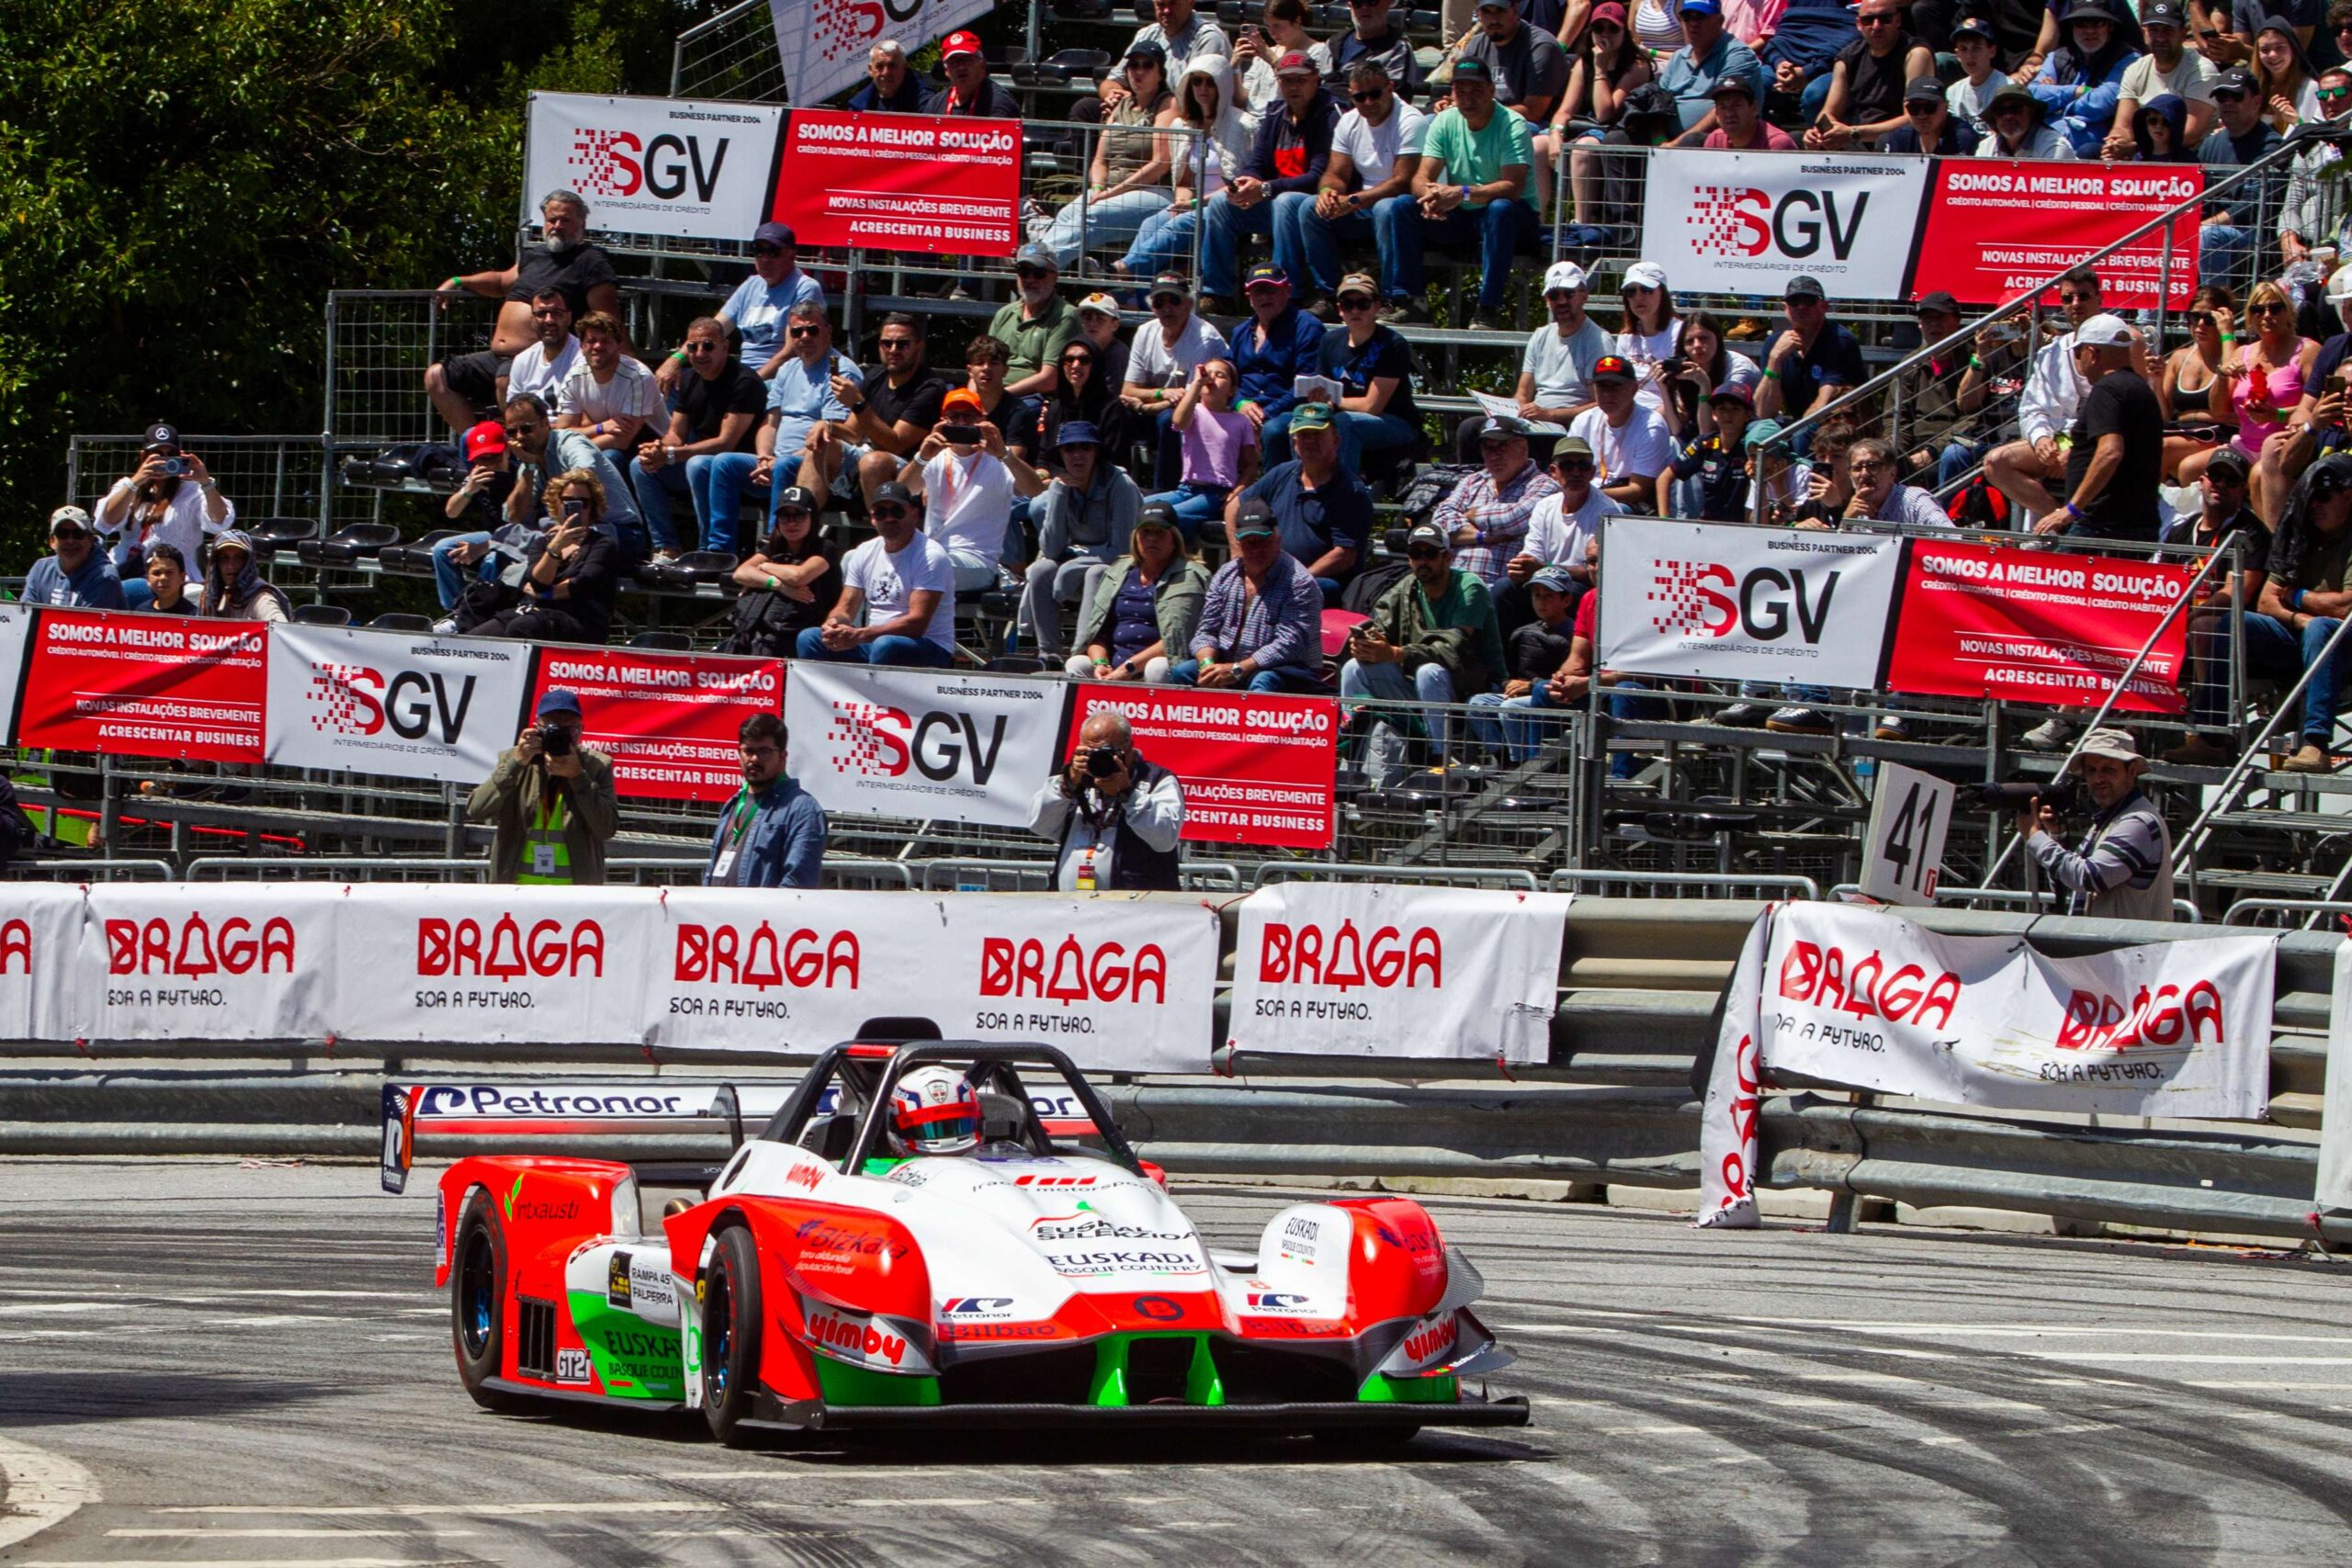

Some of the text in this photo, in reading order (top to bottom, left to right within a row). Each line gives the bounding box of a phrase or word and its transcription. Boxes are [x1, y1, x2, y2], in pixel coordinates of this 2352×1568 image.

[669, 111, 706, 120] BUSINESS
[707, 113, 741, 123] PARTNER
[797, 123, 1013, 152] SOMOS A MELHOR SOLUÇÃO
[797, 144, 827, 154] CRÉDITO
[828, 147, 870, 158] AUTOMÓVEL
[875, 150, 904, 159] CRÉDITO
[905, 152, 937, 161] PESSOAL
[941, 152, 969, 163] CRÉDITO
[600, 130, 729, 202] SGV
[1801, 165, 1905, 175] BUSINESS PARTNER 2004
[1948, 174, 2194, 200] SOMOS A MELHOR SOLUÇÃO
[674, 205, 711, 214] CRÉDITO
[829, 197, 1011, 218] NOVAS INSTALAÇÕES BREVEMENTE
[1947, 196, 2145, 211] CRÉDITO AUTOMÓVEL CRÉDITO PESSOAL CRÉDITO
[850, 221, 1010, 242] ACRESCENTAR BUSINESS
[1723, 187, 1871, 261] SGV
[1982, 250, 2024, 263] NOVAS
[1792, 264, 1806, 272] DE
[1807, 264, 1847, 274] CRÉDITO
[2115, 281, 2188, 294] BUSINSS
[1768, 541, 1877, 555] BUSINESS PARTNER 2004
[1922, 555, 2180, 600] SOMOS A MELHOR SOLUÇÃO
[1689, 563, 1840, 644] SGV
[1921, 580, 2128, 609] CRÉDITO CRÉDITO PESSOAL CRÉDITO
[48, 623, 262, 654] SOMOS A MELHOR SOLUÇÃO
[47, 645, 77, 656] CRÉDITO
[78, 648, 120, 660] AUTOMÓVEL
[124, 650, 154, 661] CRÉDITO
[411, 647, 510, 661] BUSINESS PARTNER 2004
[1761, 646, 1774, 655] DE
[1776, 648, 1819, 658] CRÉDITO
[1960, 639, 2091, 663] NOVAS INSTALAÇÕES
[548, 661, 775, 694] SOMOS A MELHOR SOLUÇÃO
[1984, 669, 2097, 689] ACRESCENTAR
[628, 690, 662, 701] CRÉDITO
[663, 692, 695, 703] PESSOAL
[729, 695, 775, 707] HABITAÇÃO
[937, 685, 1043, 700] BUSINESS PARTNER 2004
[76, 699, 260, 723] NOVAS INSTALAÇÕES BREVEMENTE
[340, 666, 477, 744] SGV
[1086, 699, 1329, 734] SOMOS A MELHOR SOLUÇÃO
[99, 725, 259, 747] ACRESCENTAR BUSINESS
[863, 705, 1008, 785] SGV
[1172, 728, 1328, 748] CRÉDITO PESSOAL CRÉDITO HABITAÇÃO
[406, 744, 420, 752] DE
[581, 739, 696, 760] NOVAS INSTALAÇÕES
[613, 767, 702, 784] CRESCENTAR
[934, 786, 947, 795] DE
[949, 786, 987, 798] CRÉDITO
[1245, 788, 1325, 806] BREVEMENTE
[1252, 815, 1325, 831] BUSINESS
[1883, 782, 1938, 892] 41
[105, 911, 294, 981] BRAGA
[417, 912, 604, 982] BRAGA
[1260, 919, 1442, 992] BRAGA
[674, 920, 860, 992] BRAGA
[979, 934, 1166, 1007] BRAGA
[1780, 940, 1962, 1031] BRAGA
[108, 989, 133, 1006] SOA
[140, 989, 152, 1006] A
[416, 991, 447, 1008] SOA
[452, 992, 463, 1008] A
[670, 998, 703, 1015] SOA
[708, 999, 718, 1016] A
[1256, 999, 1285, 1015] SOA
[1291, 1000, 1301, 1018] A
[976, 1012, 1008, 1030] SOA
[1013, 1014, 1023, 1030] A
[1800, 1023, 1815, 1039] A
[2073, 1064, 2086, 1082] A
[470, 1087, 681, 1114] Petronor
[1285, 1216, 1320, 1242] EUSKADI
[1296, 1242, 1316, 1256] COUNTRY
[1045, 1252, 1195, 1266] EUSKADI
[1120, 1263, 1202, 1273] COUNTRY
[632, 1268, 659, 1281] RAMPA
[633, 1287, 673, 1304] FALPERRA
[604, 1330, 683, 1359] EUSKA
[809, 1311, 906, 1365] yimby
